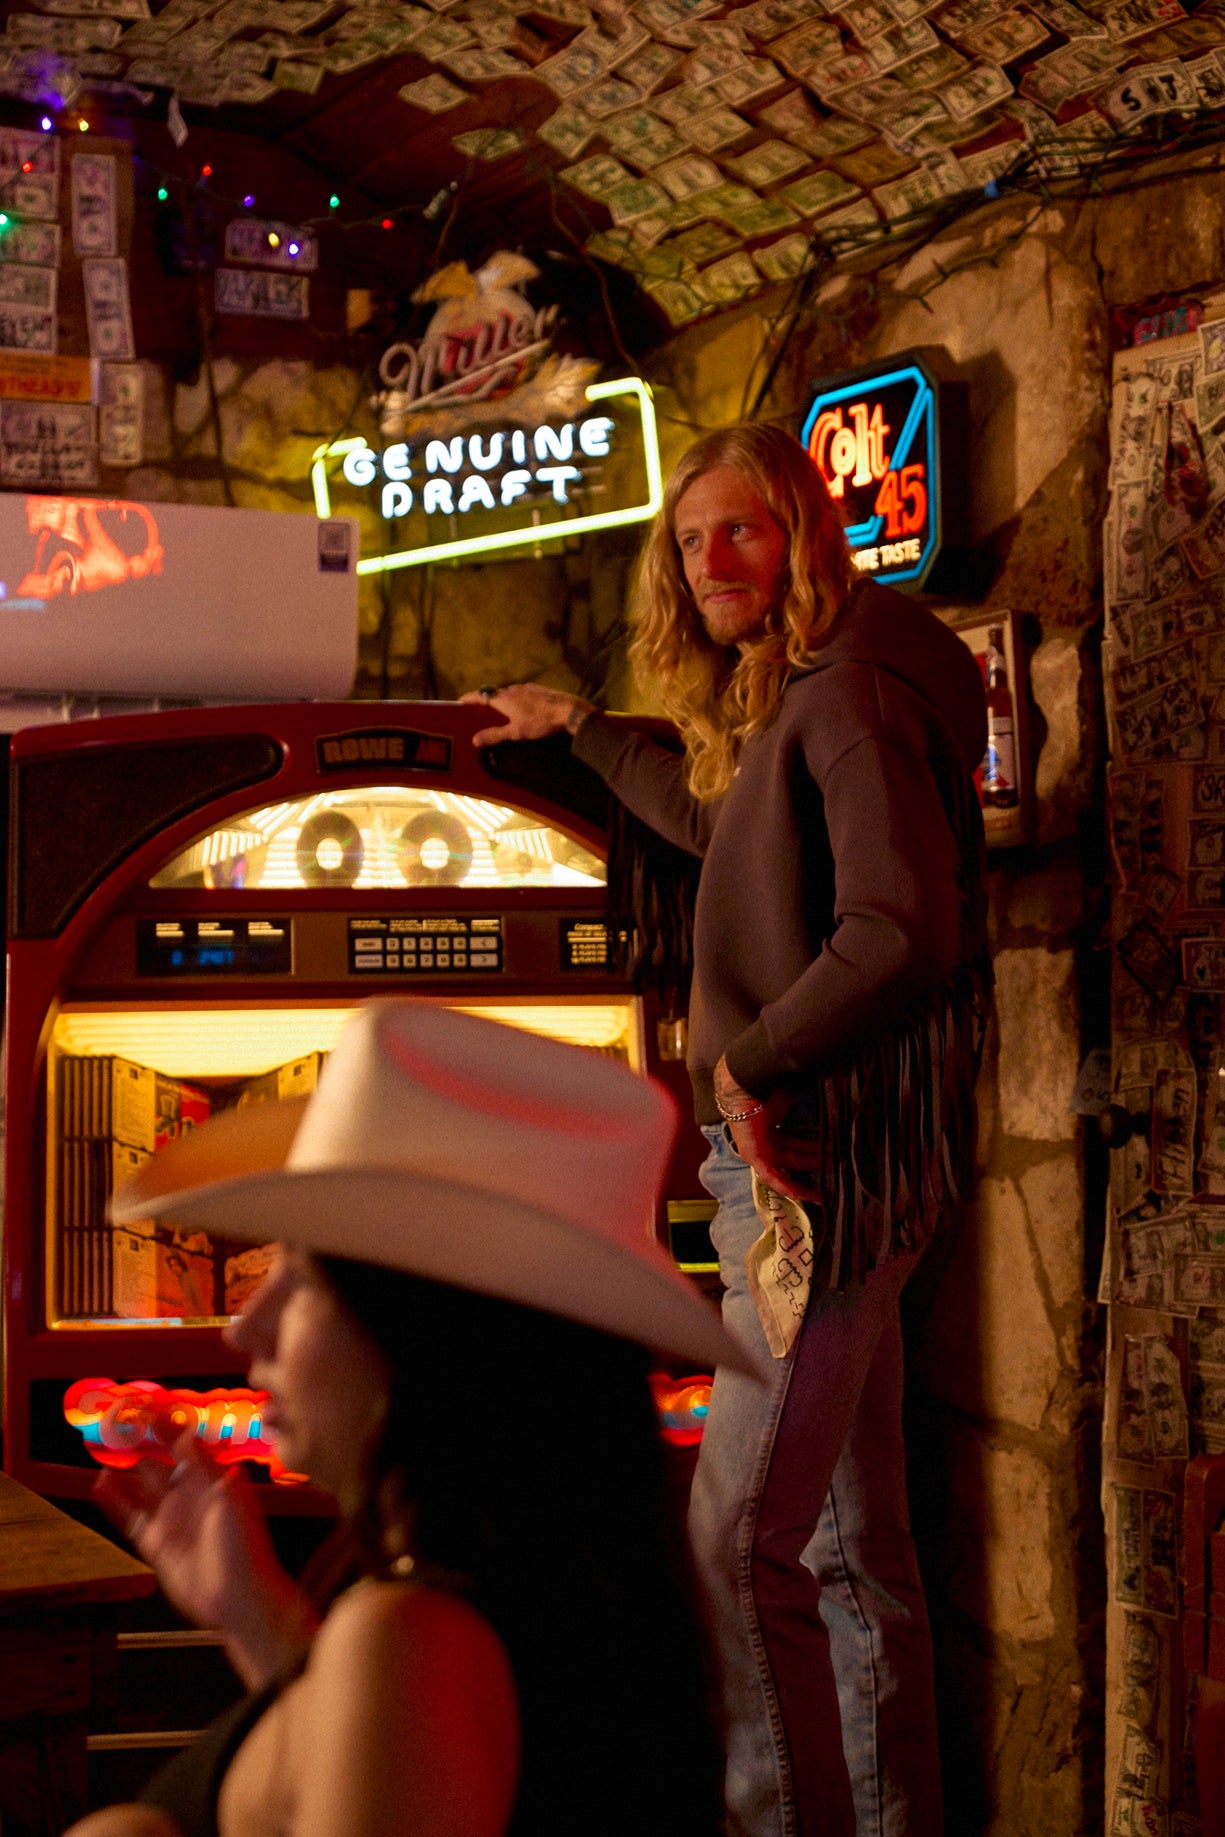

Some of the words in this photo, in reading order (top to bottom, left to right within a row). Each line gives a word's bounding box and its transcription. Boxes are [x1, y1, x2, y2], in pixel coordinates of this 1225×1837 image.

[378, 304, 560, 408] Miller
[343, 417, 615, 486] GENUINE
[809, 403, 890, 498] Colt
[381, 465, 582, 519] DRAFT
[874, 463, 927, 539] 45
[880, 538, 921, 565] TASTE
[323, 738, 405, 763] ROWE
